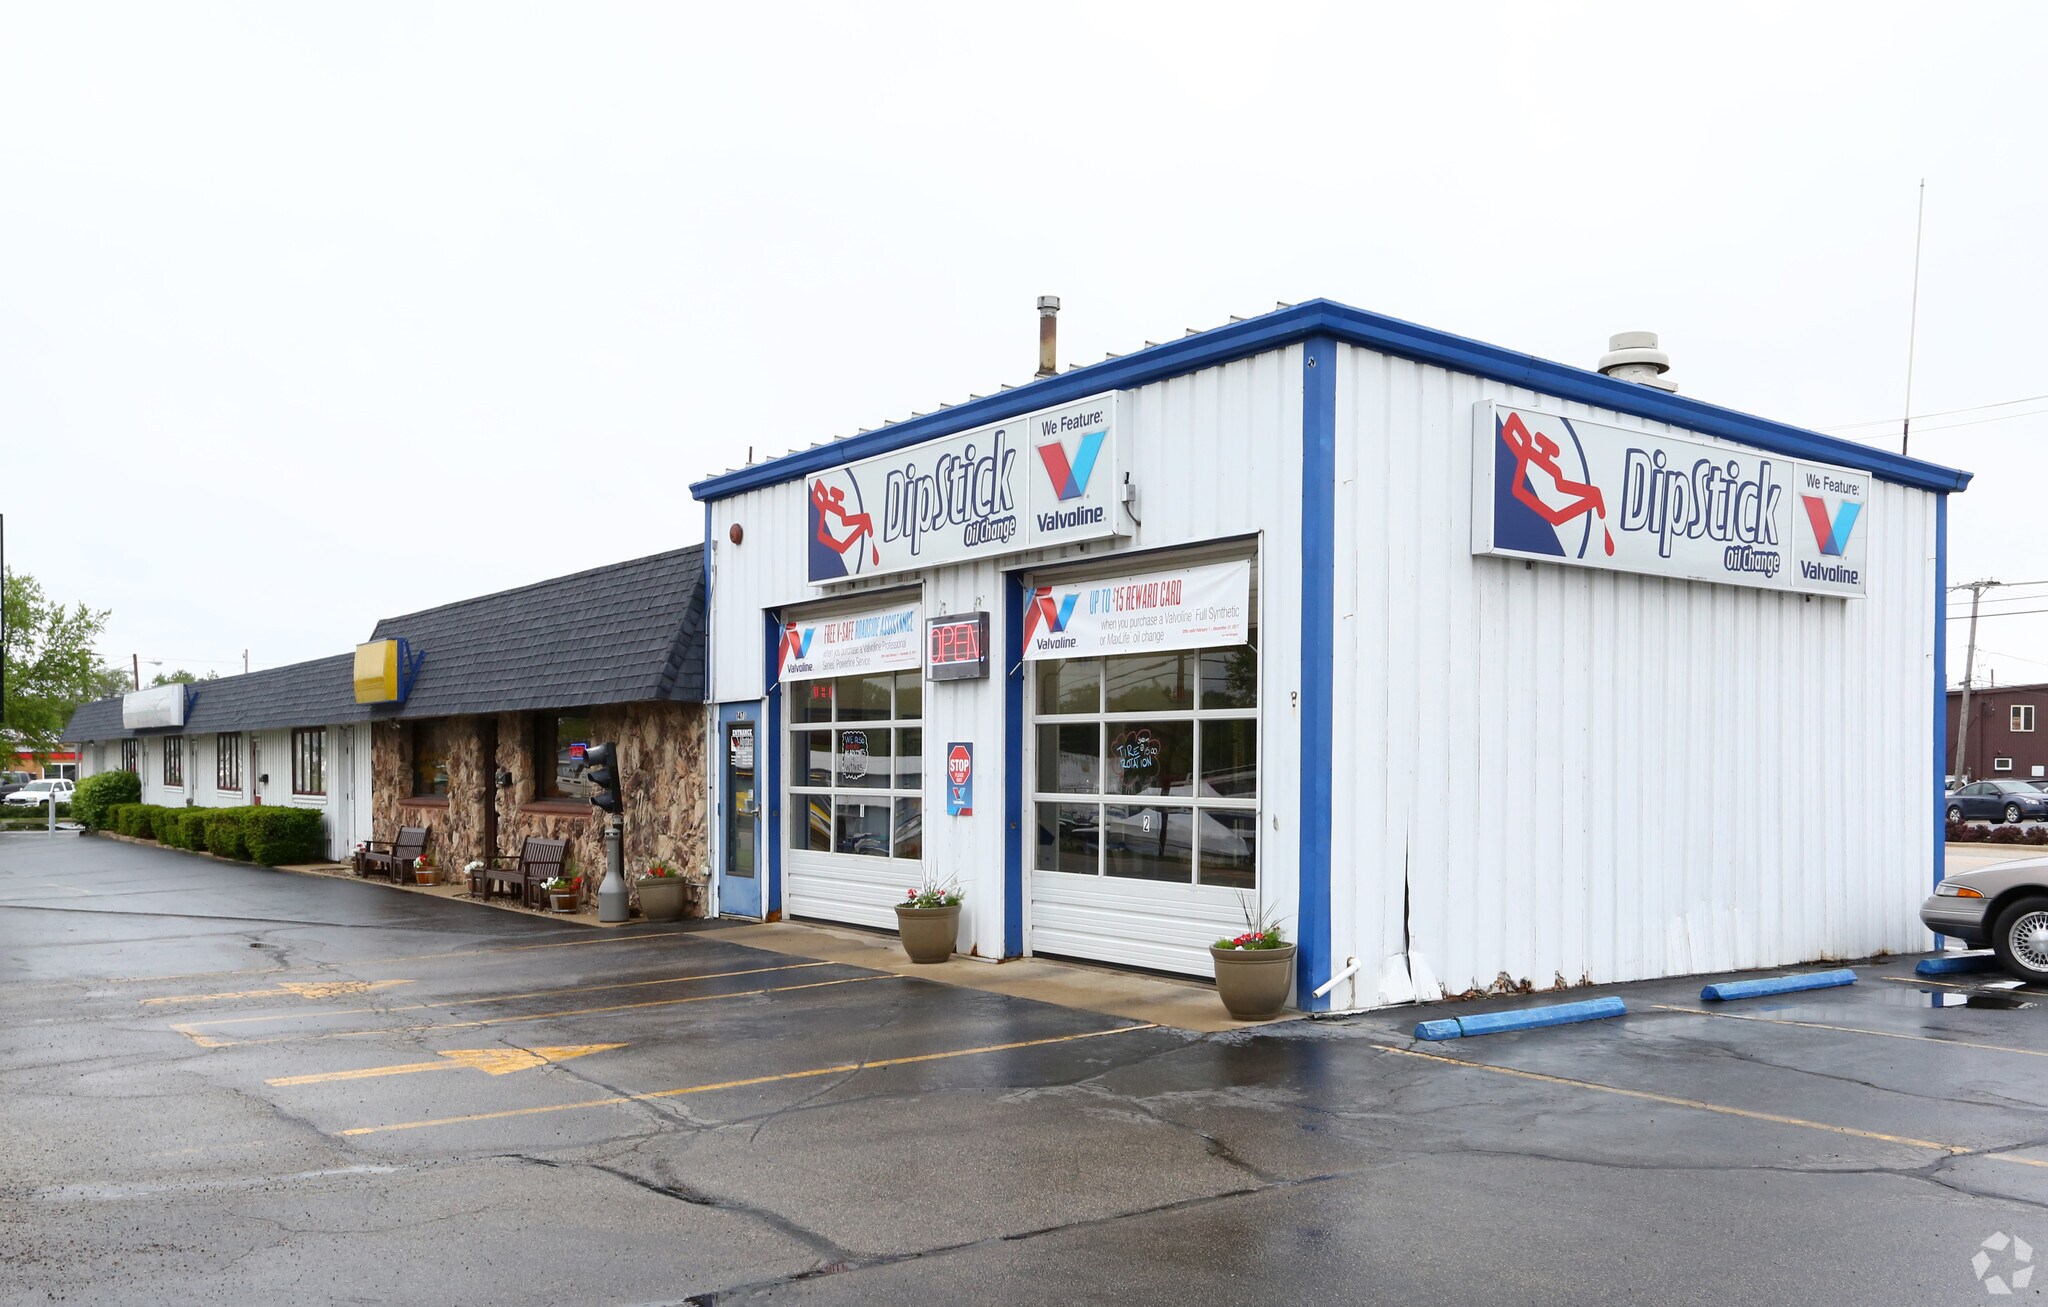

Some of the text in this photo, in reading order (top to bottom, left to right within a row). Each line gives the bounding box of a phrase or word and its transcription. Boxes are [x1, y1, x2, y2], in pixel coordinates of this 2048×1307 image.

[1042, 411, 1103, 436] We Feature:
[884, 430, 1017, 556] DipStick
[1806, 473, 1860, 496] We Feature:
[1620, 447, 1783, 558] DipStick
[963, 515, 1017, 547] Oil Change
[1037, 506, 1104, 532] Valvoline
[1723, 545, 1781, 578] Oil Change
[1800, 560, 1859, 585] Valvoline
[1089, 579, 1182, 615] UP TO $15 REWARD CARD
[1101, 618, 1117, 630] when
[1118, 619, 1129, 631] you
[1129, 614, 1158, 630] purchase
[1164, 610, 1192, 625] Valvoline
[1195, 608, 1208, 621] Full
[1208, 604, 1240, 622] Synthetic
[930, 624, 980, 663] OPEN
[1037, 636, 1077, 650] Valvoline
[1099, 631, 1165, 646] or MaxLife oil change
[787, 663, 813, 673] Valvoline
[1117, 745, 1139, 756] TIRE
[1120, 755, 1152, 769] ROTATION
[950, 759, 969, 772] STOP
[1144, 816, 1149, 831] 2
